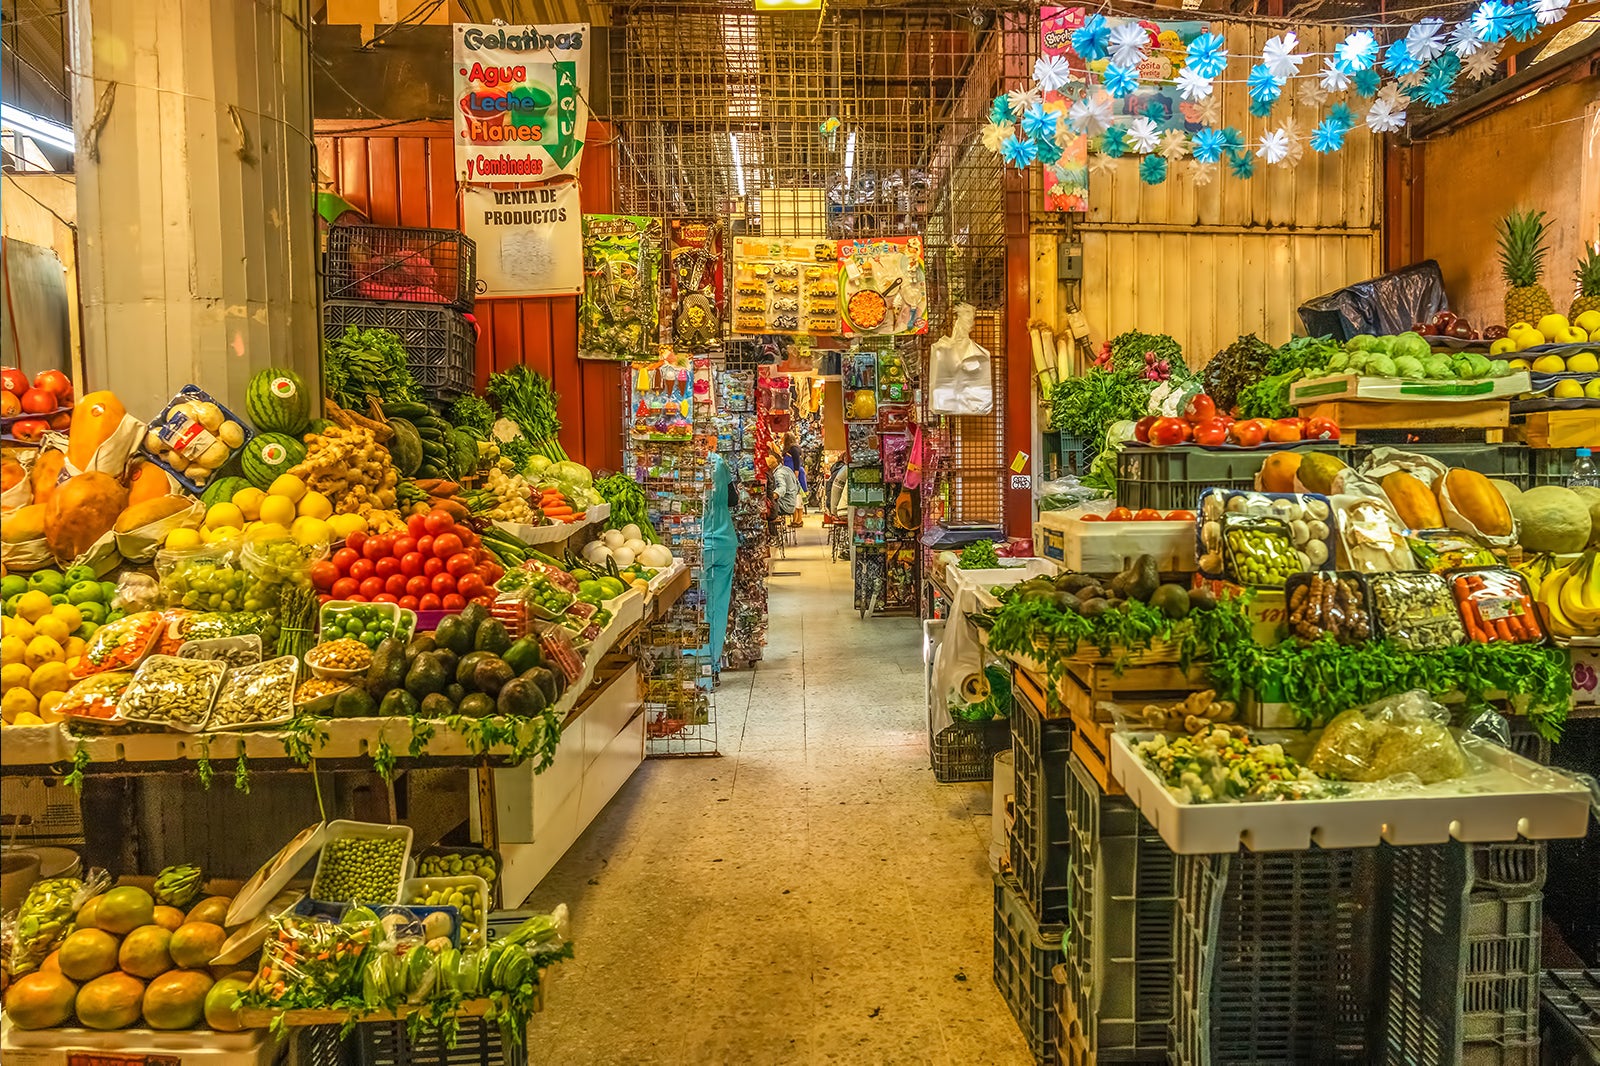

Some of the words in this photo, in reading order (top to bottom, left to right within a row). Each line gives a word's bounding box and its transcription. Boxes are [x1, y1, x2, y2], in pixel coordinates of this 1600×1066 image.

[464, 28, 583, 51] Gelatinas
[469, 62, 527, 88] Agua
[470, 91, 535, 112] Leche
[559, 71, 576, 158] AQUI
[471, 121, 542, 142] Flanes
[467, 159, 475, 180] y
[476, 154, 544, 176] Combinadas
[494, 190, 538, 205] VENTA
[540, 189, 557, 203] DE
[484, 208, 567, 226] PRODUCTOS
